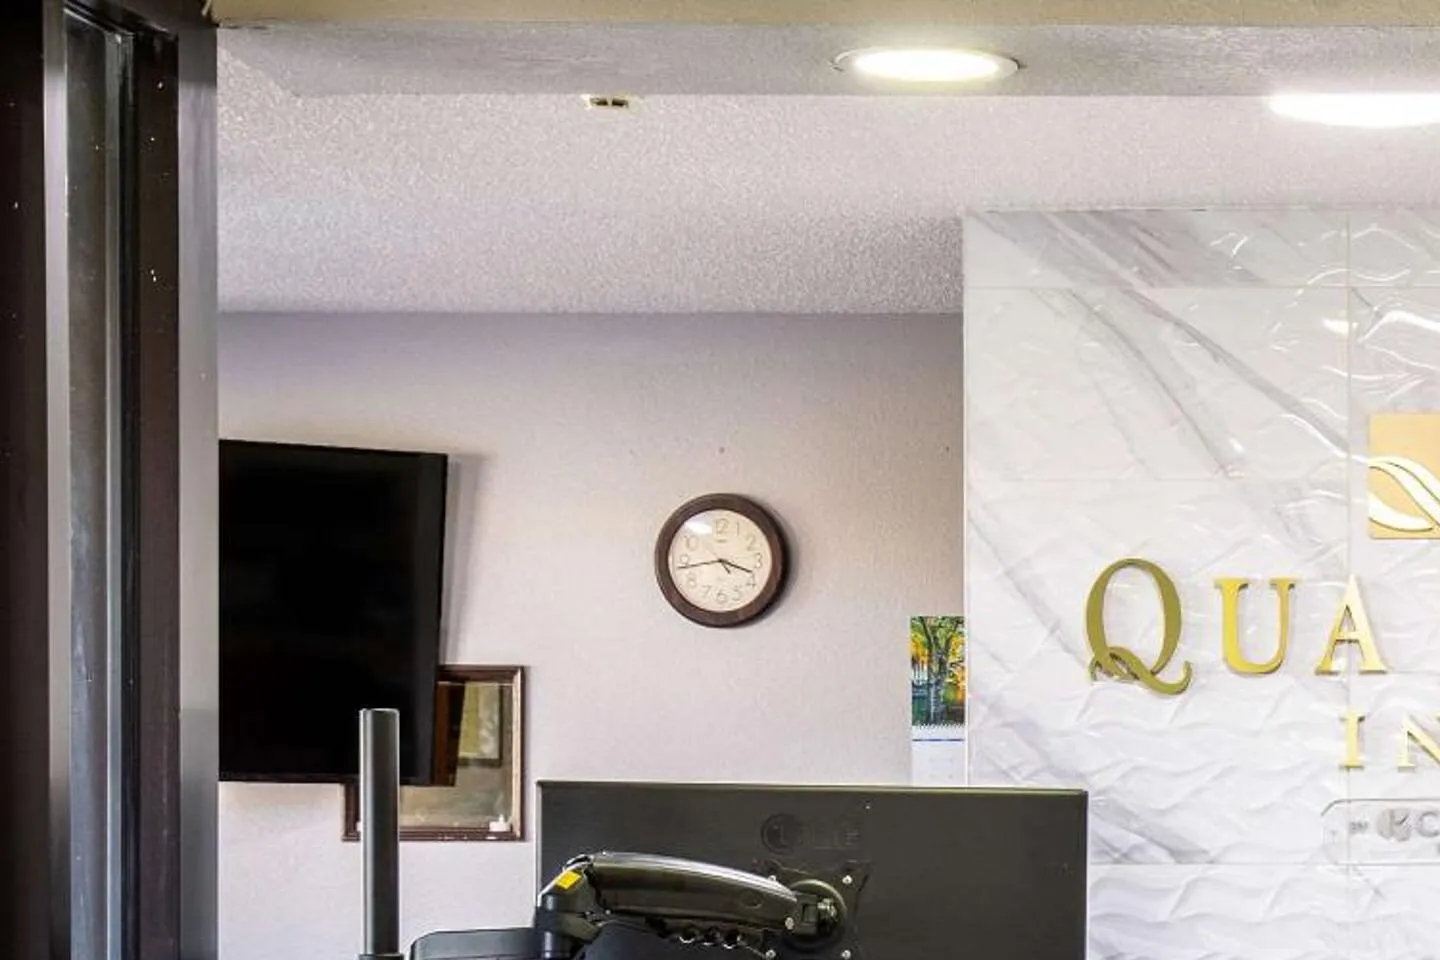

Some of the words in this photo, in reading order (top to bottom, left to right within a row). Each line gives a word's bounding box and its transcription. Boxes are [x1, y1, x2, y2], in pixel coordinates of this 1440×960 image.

[715, 518, 730, 536] 12
[746, 533, 757, 551] 2
[754, 552, 763, 569] 3
[701, 584, 713, 599] 7
[716, 588, 729, 605] 6
